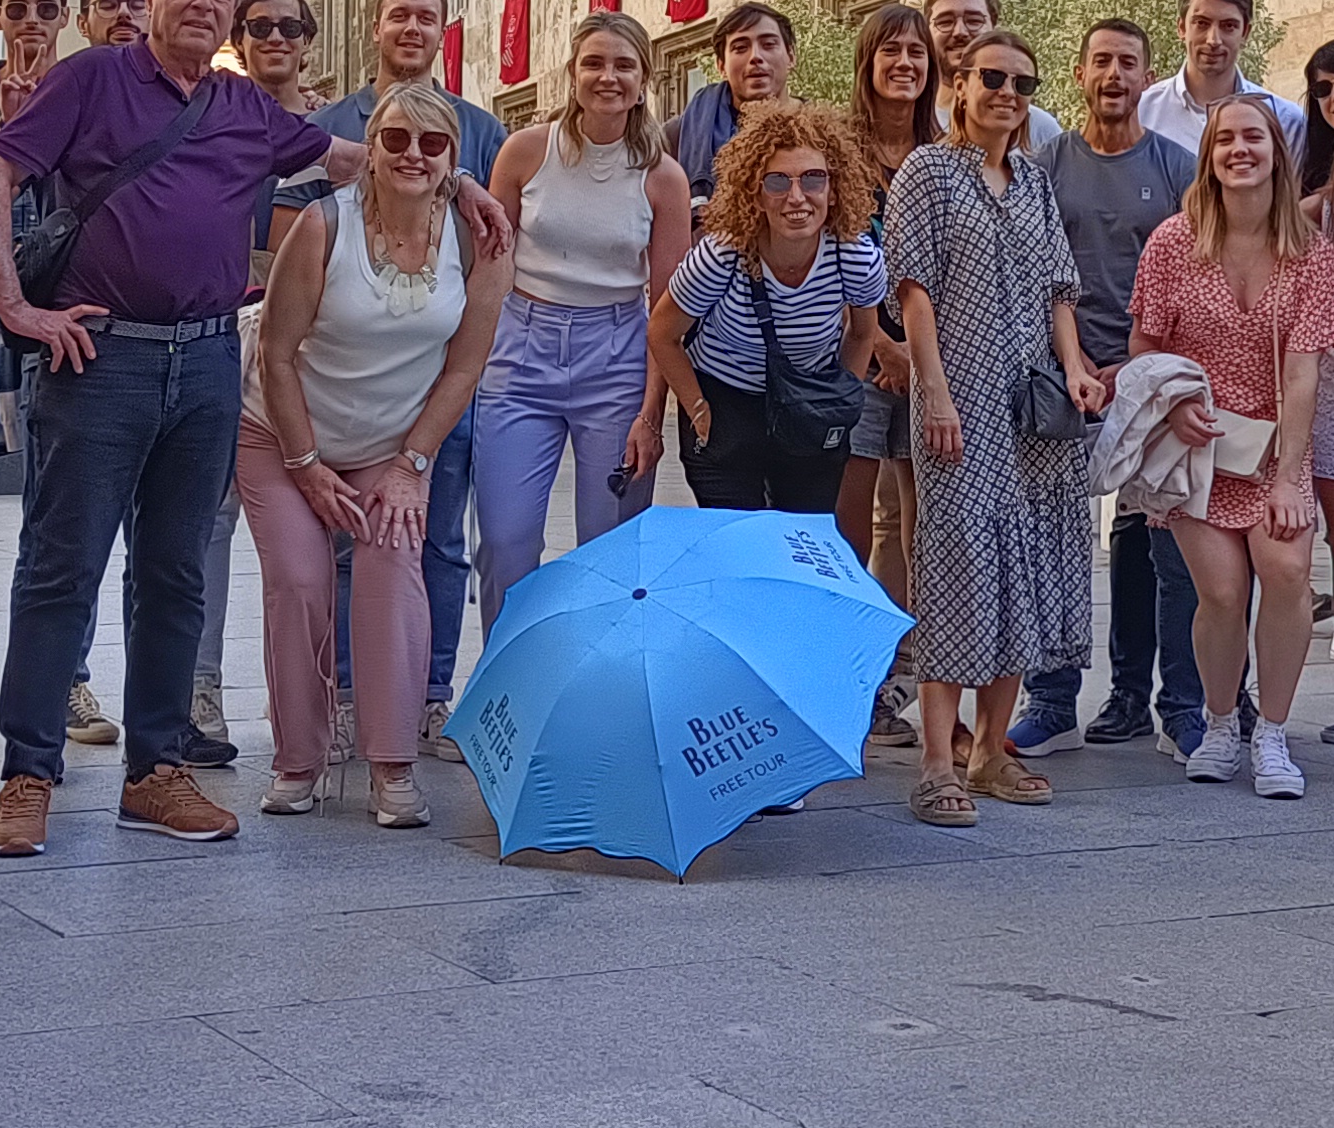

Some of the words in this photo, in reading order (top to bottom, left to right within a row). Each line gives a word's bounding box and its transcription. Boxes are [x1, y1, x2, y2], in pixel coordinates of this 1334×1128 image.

[783, 534, 815, 565] BLUE
[495, 693, 518, 745] BLUE
[687, 705, 750, 747] BLUE
[470, 734, 485, 761] FREE
[681, 717, 779, 778] BEETLE'S
[709, 773, 748, 802] FREE
[743, 753, 788, 781] TOUR
